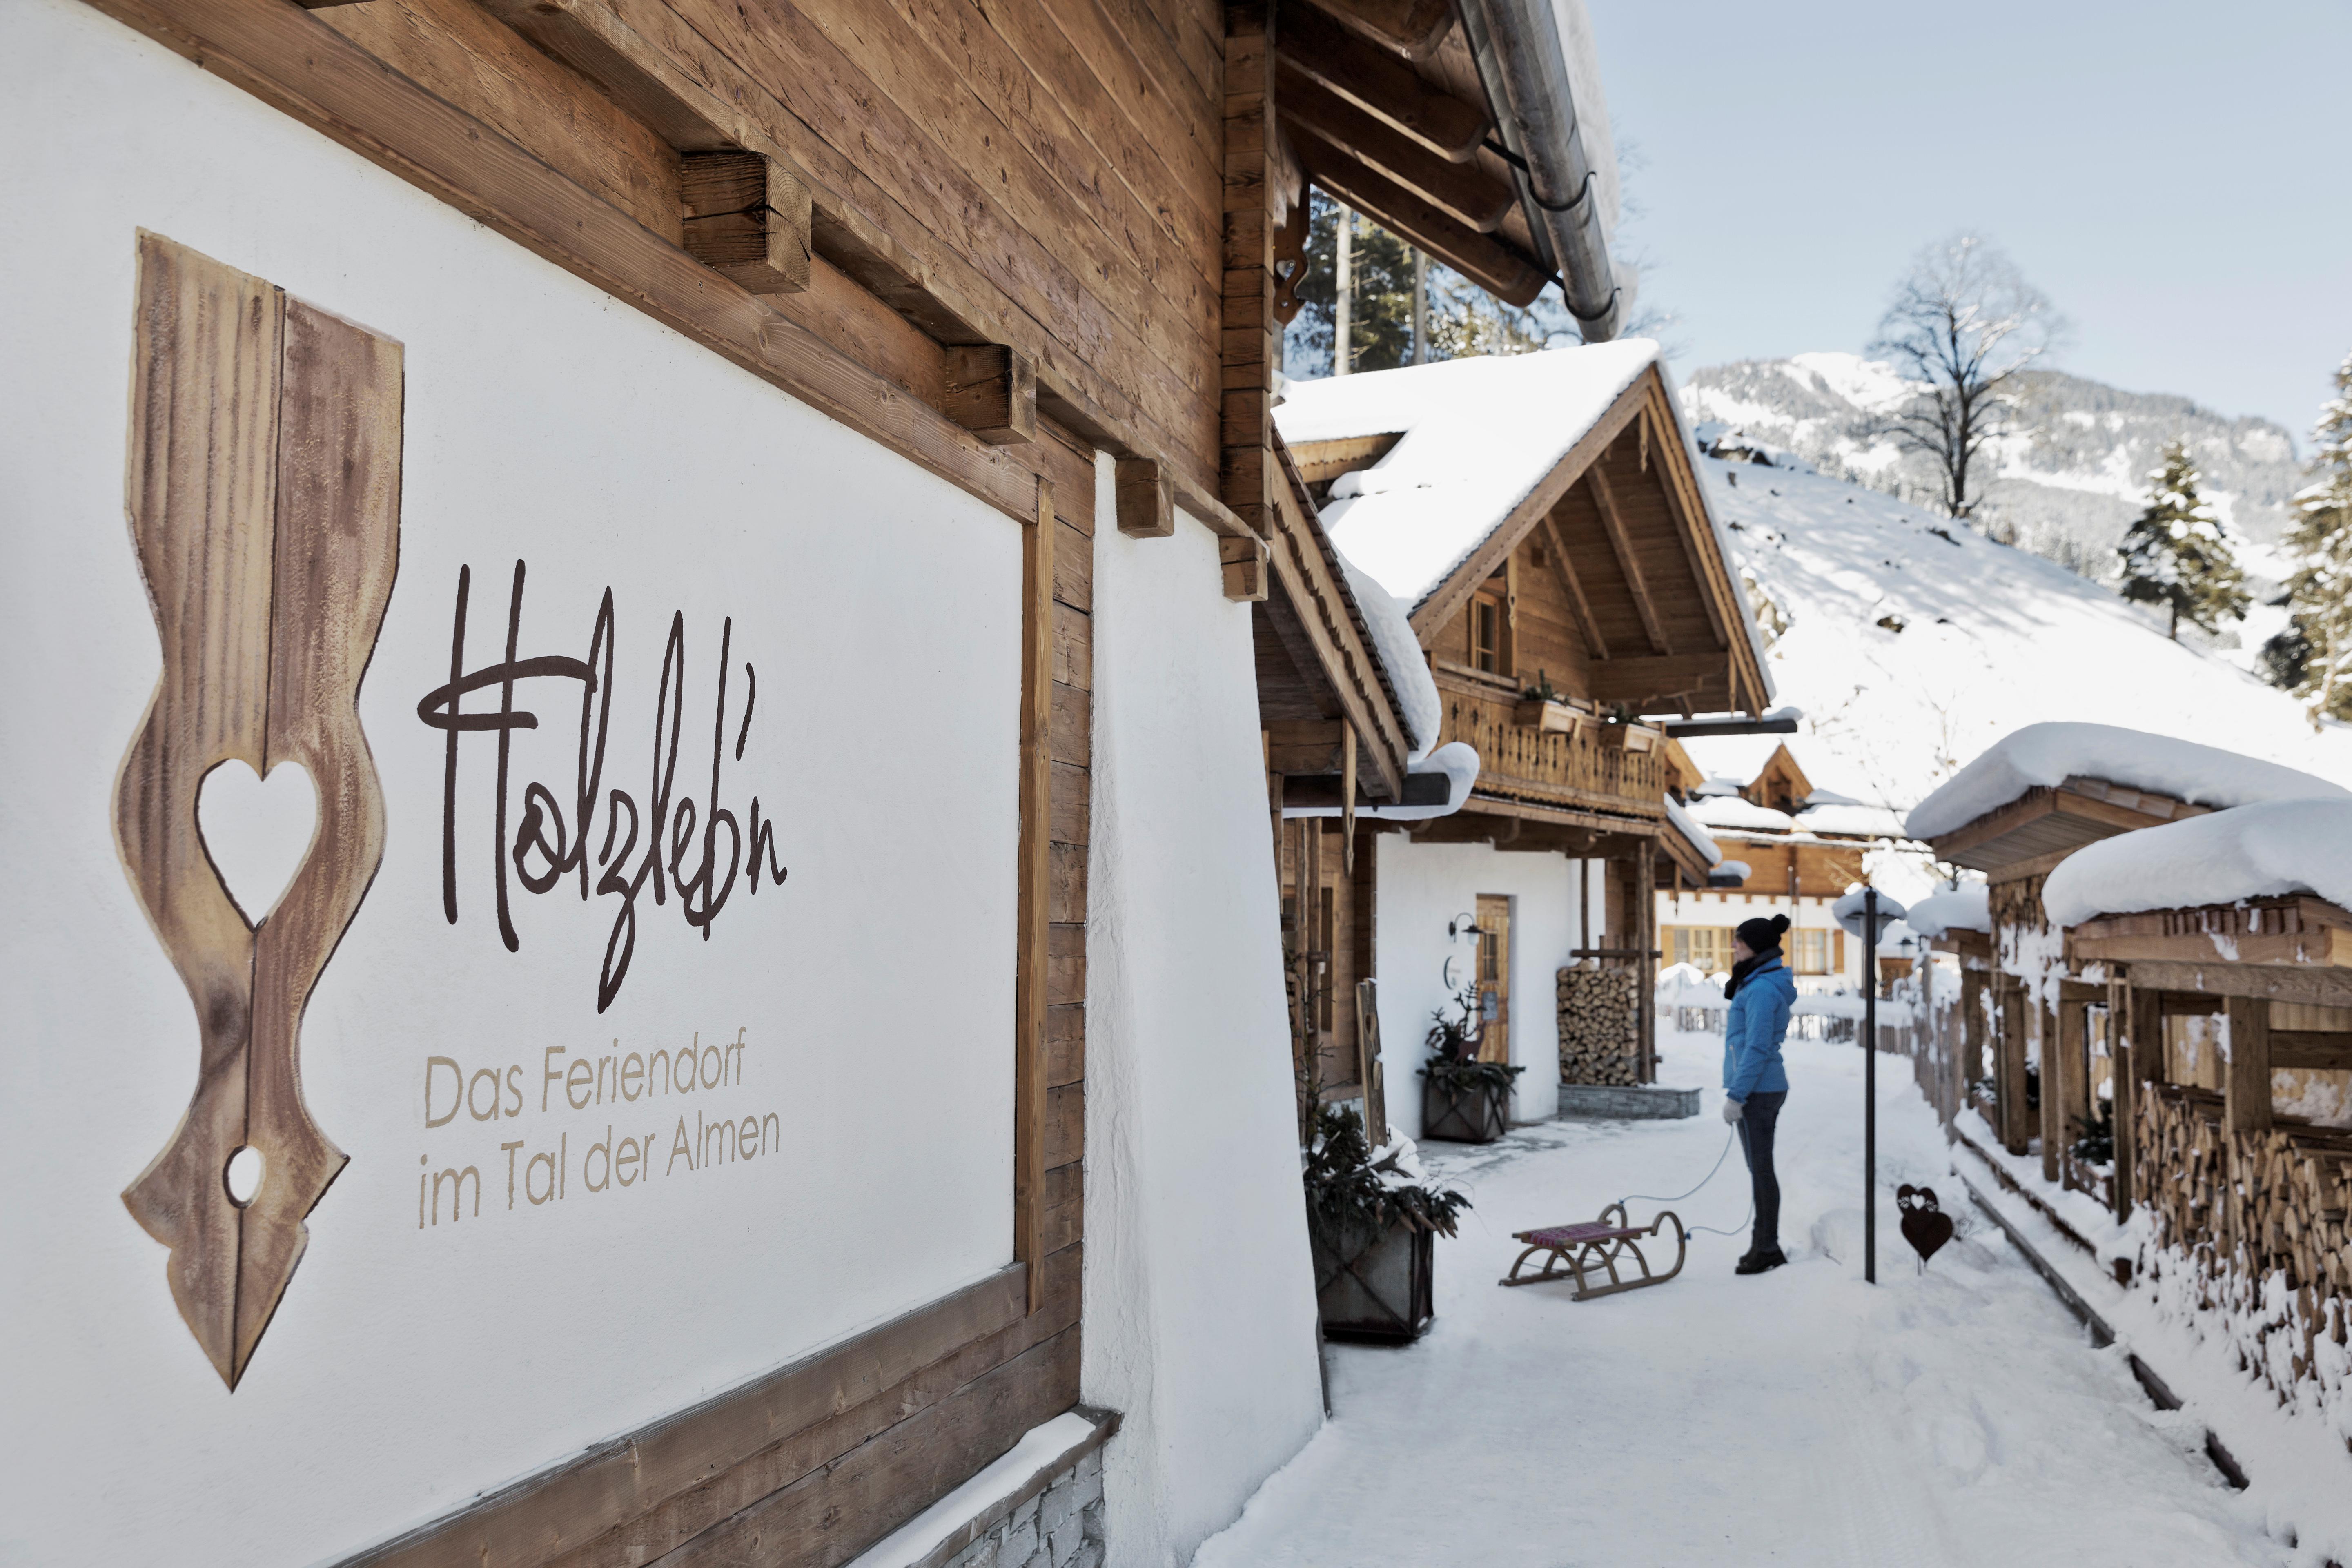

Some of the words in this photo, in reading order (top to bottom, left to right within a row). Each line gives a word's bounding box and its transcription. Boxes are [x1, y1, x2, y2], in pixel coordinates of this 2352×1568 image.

[417, 558, 788, 1014] Holzleb'n
[425, 1056, 523, 1129] Das
[542, 1026, 747, 1112] Feriendorf
[419, 1153, 481, 1229] im
[501, 1131, 567, 1210] Tal
[584, 1124, 656, 1193] der
[666, 1110, 780, 1176] Almen
